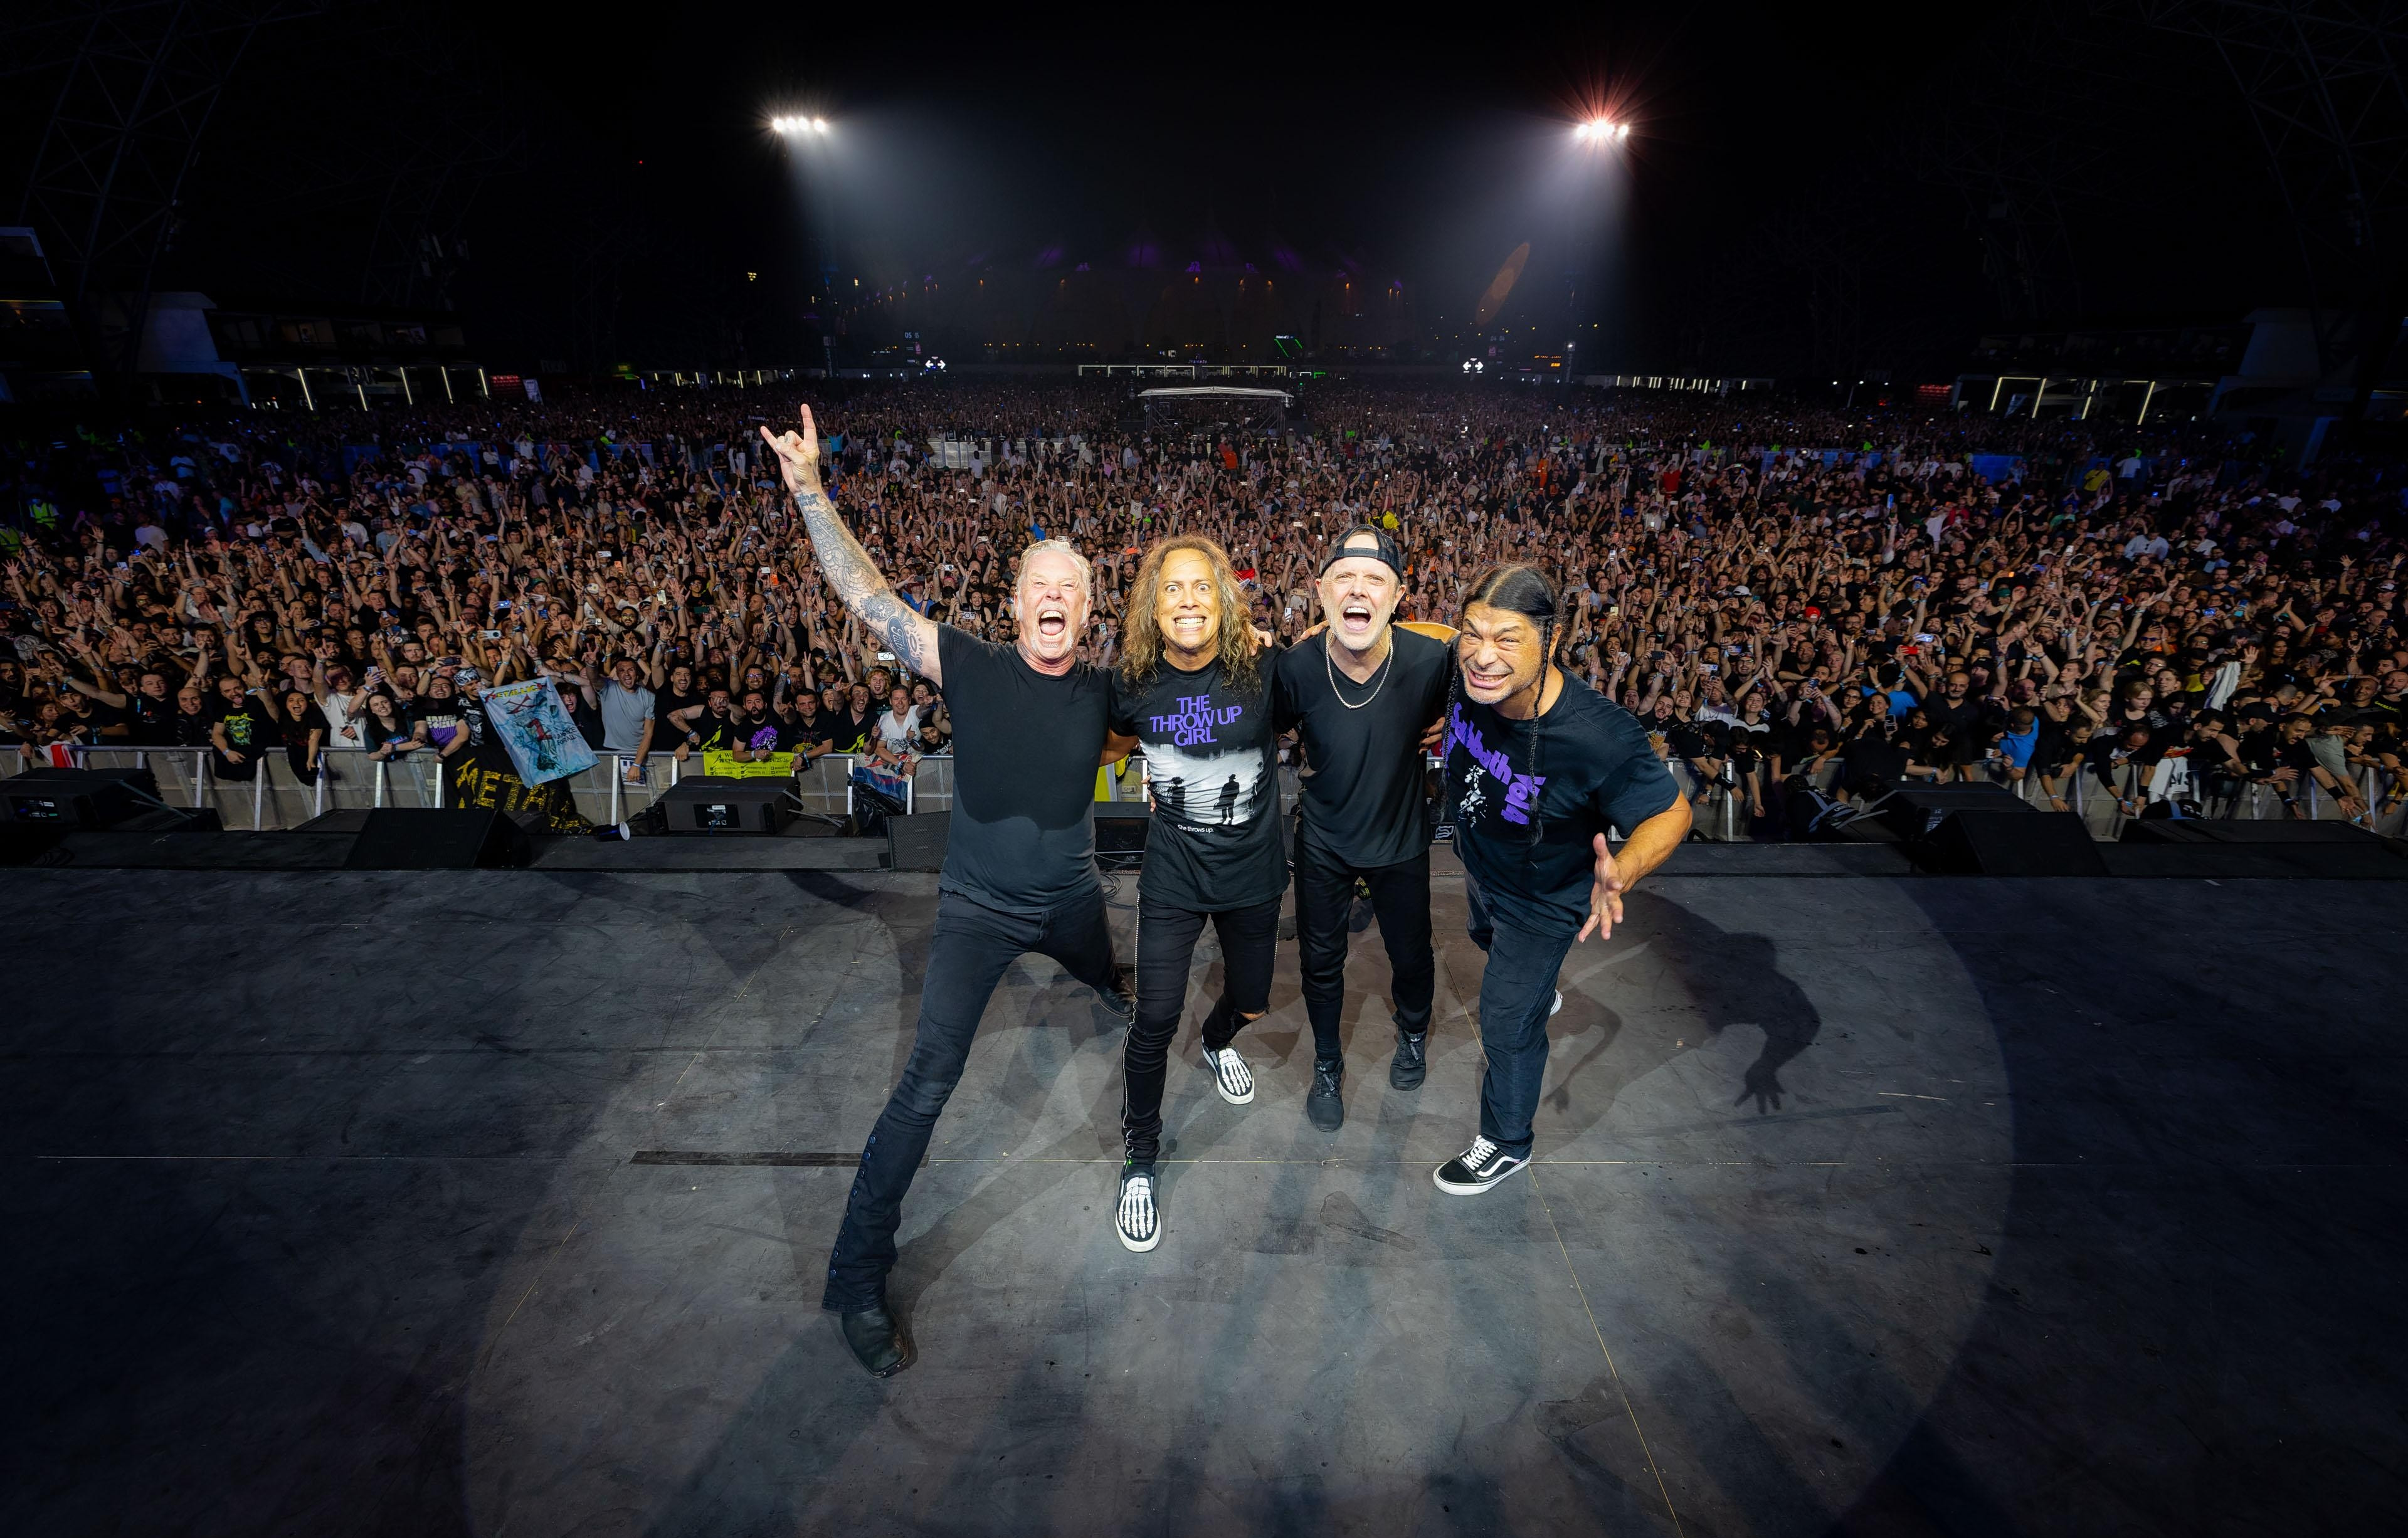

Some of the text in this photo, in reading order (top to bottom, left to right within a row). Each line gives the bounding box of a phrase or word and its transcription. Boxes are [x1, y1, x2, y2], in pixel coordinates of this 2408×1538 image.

[1176, 694, 1211, 714] THE
[1149, 705, 1242, 733] THROW UP
[1173, 727, 1218, 746] GIRL
[1187, 825, 1205, 833] throws
